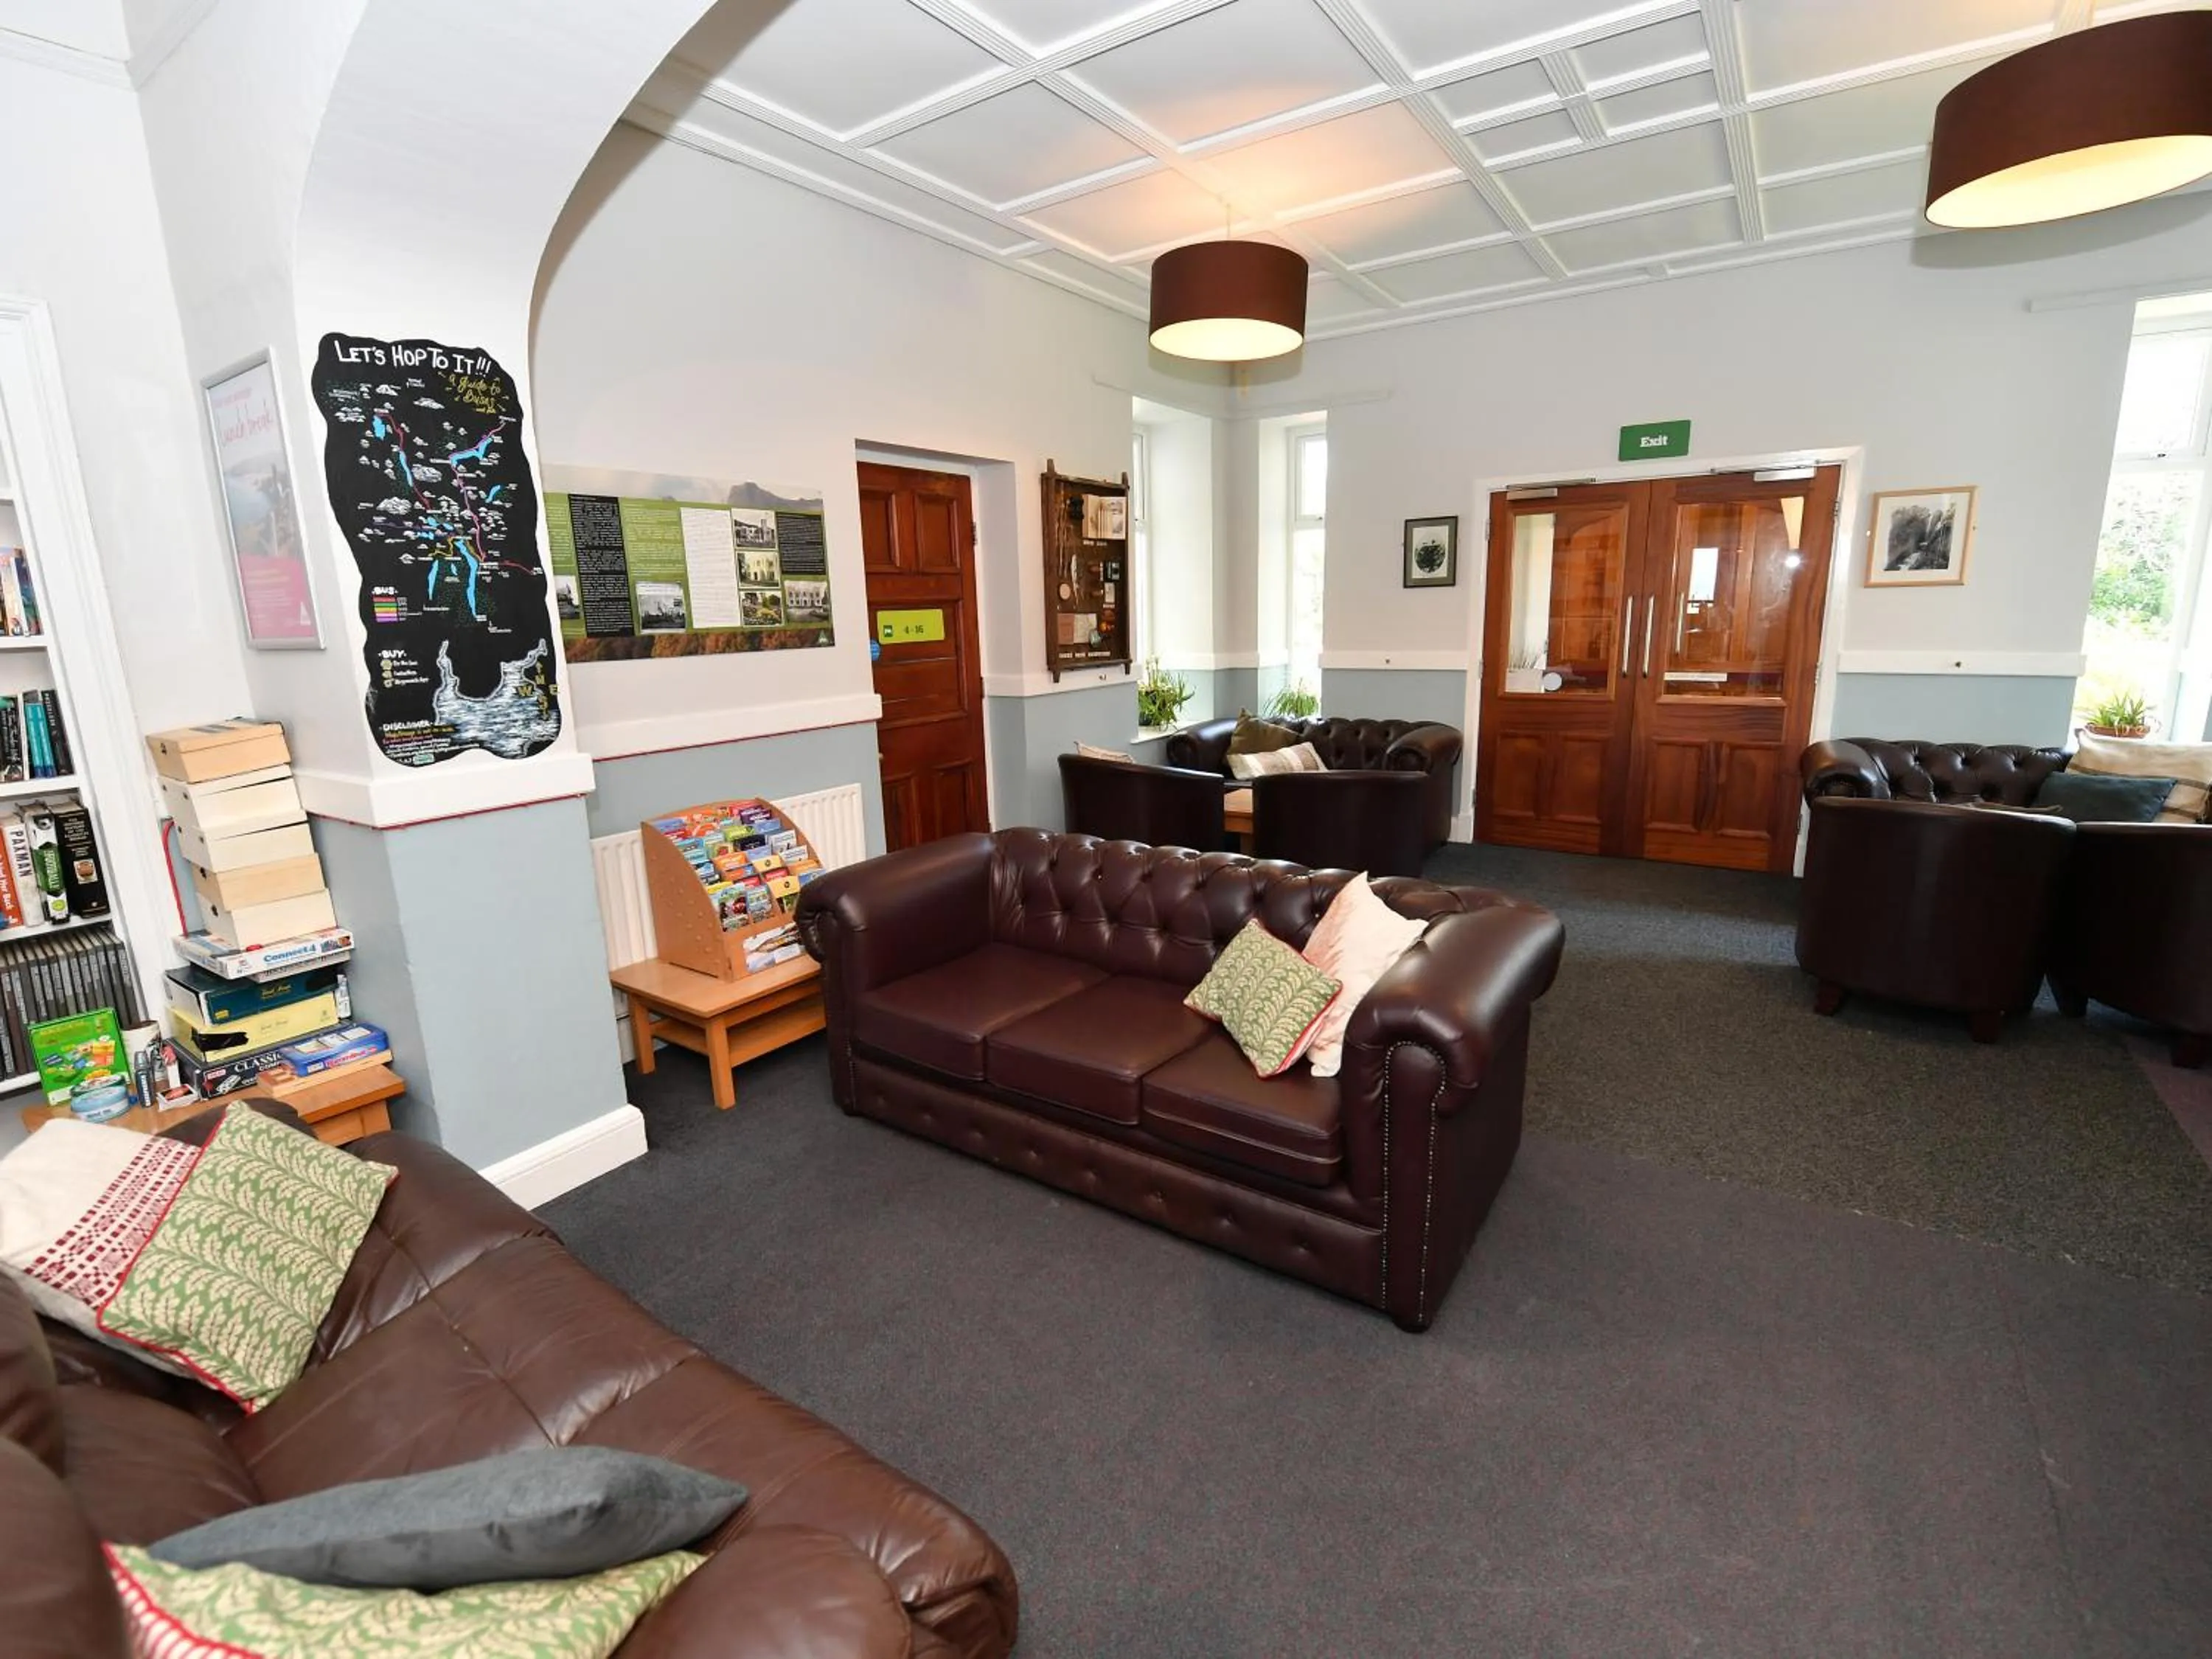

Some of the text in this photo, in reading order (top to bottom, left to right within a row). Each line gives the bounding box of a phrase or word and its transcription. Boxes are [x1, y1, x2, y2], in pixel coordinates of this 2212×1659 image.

[333, 340, 386, 366] LET'S
[392, 344, 427, 368] HOP
[1639, 434, 1669, 448] Exit
[10, 830, 33, 877] PAXMAN
